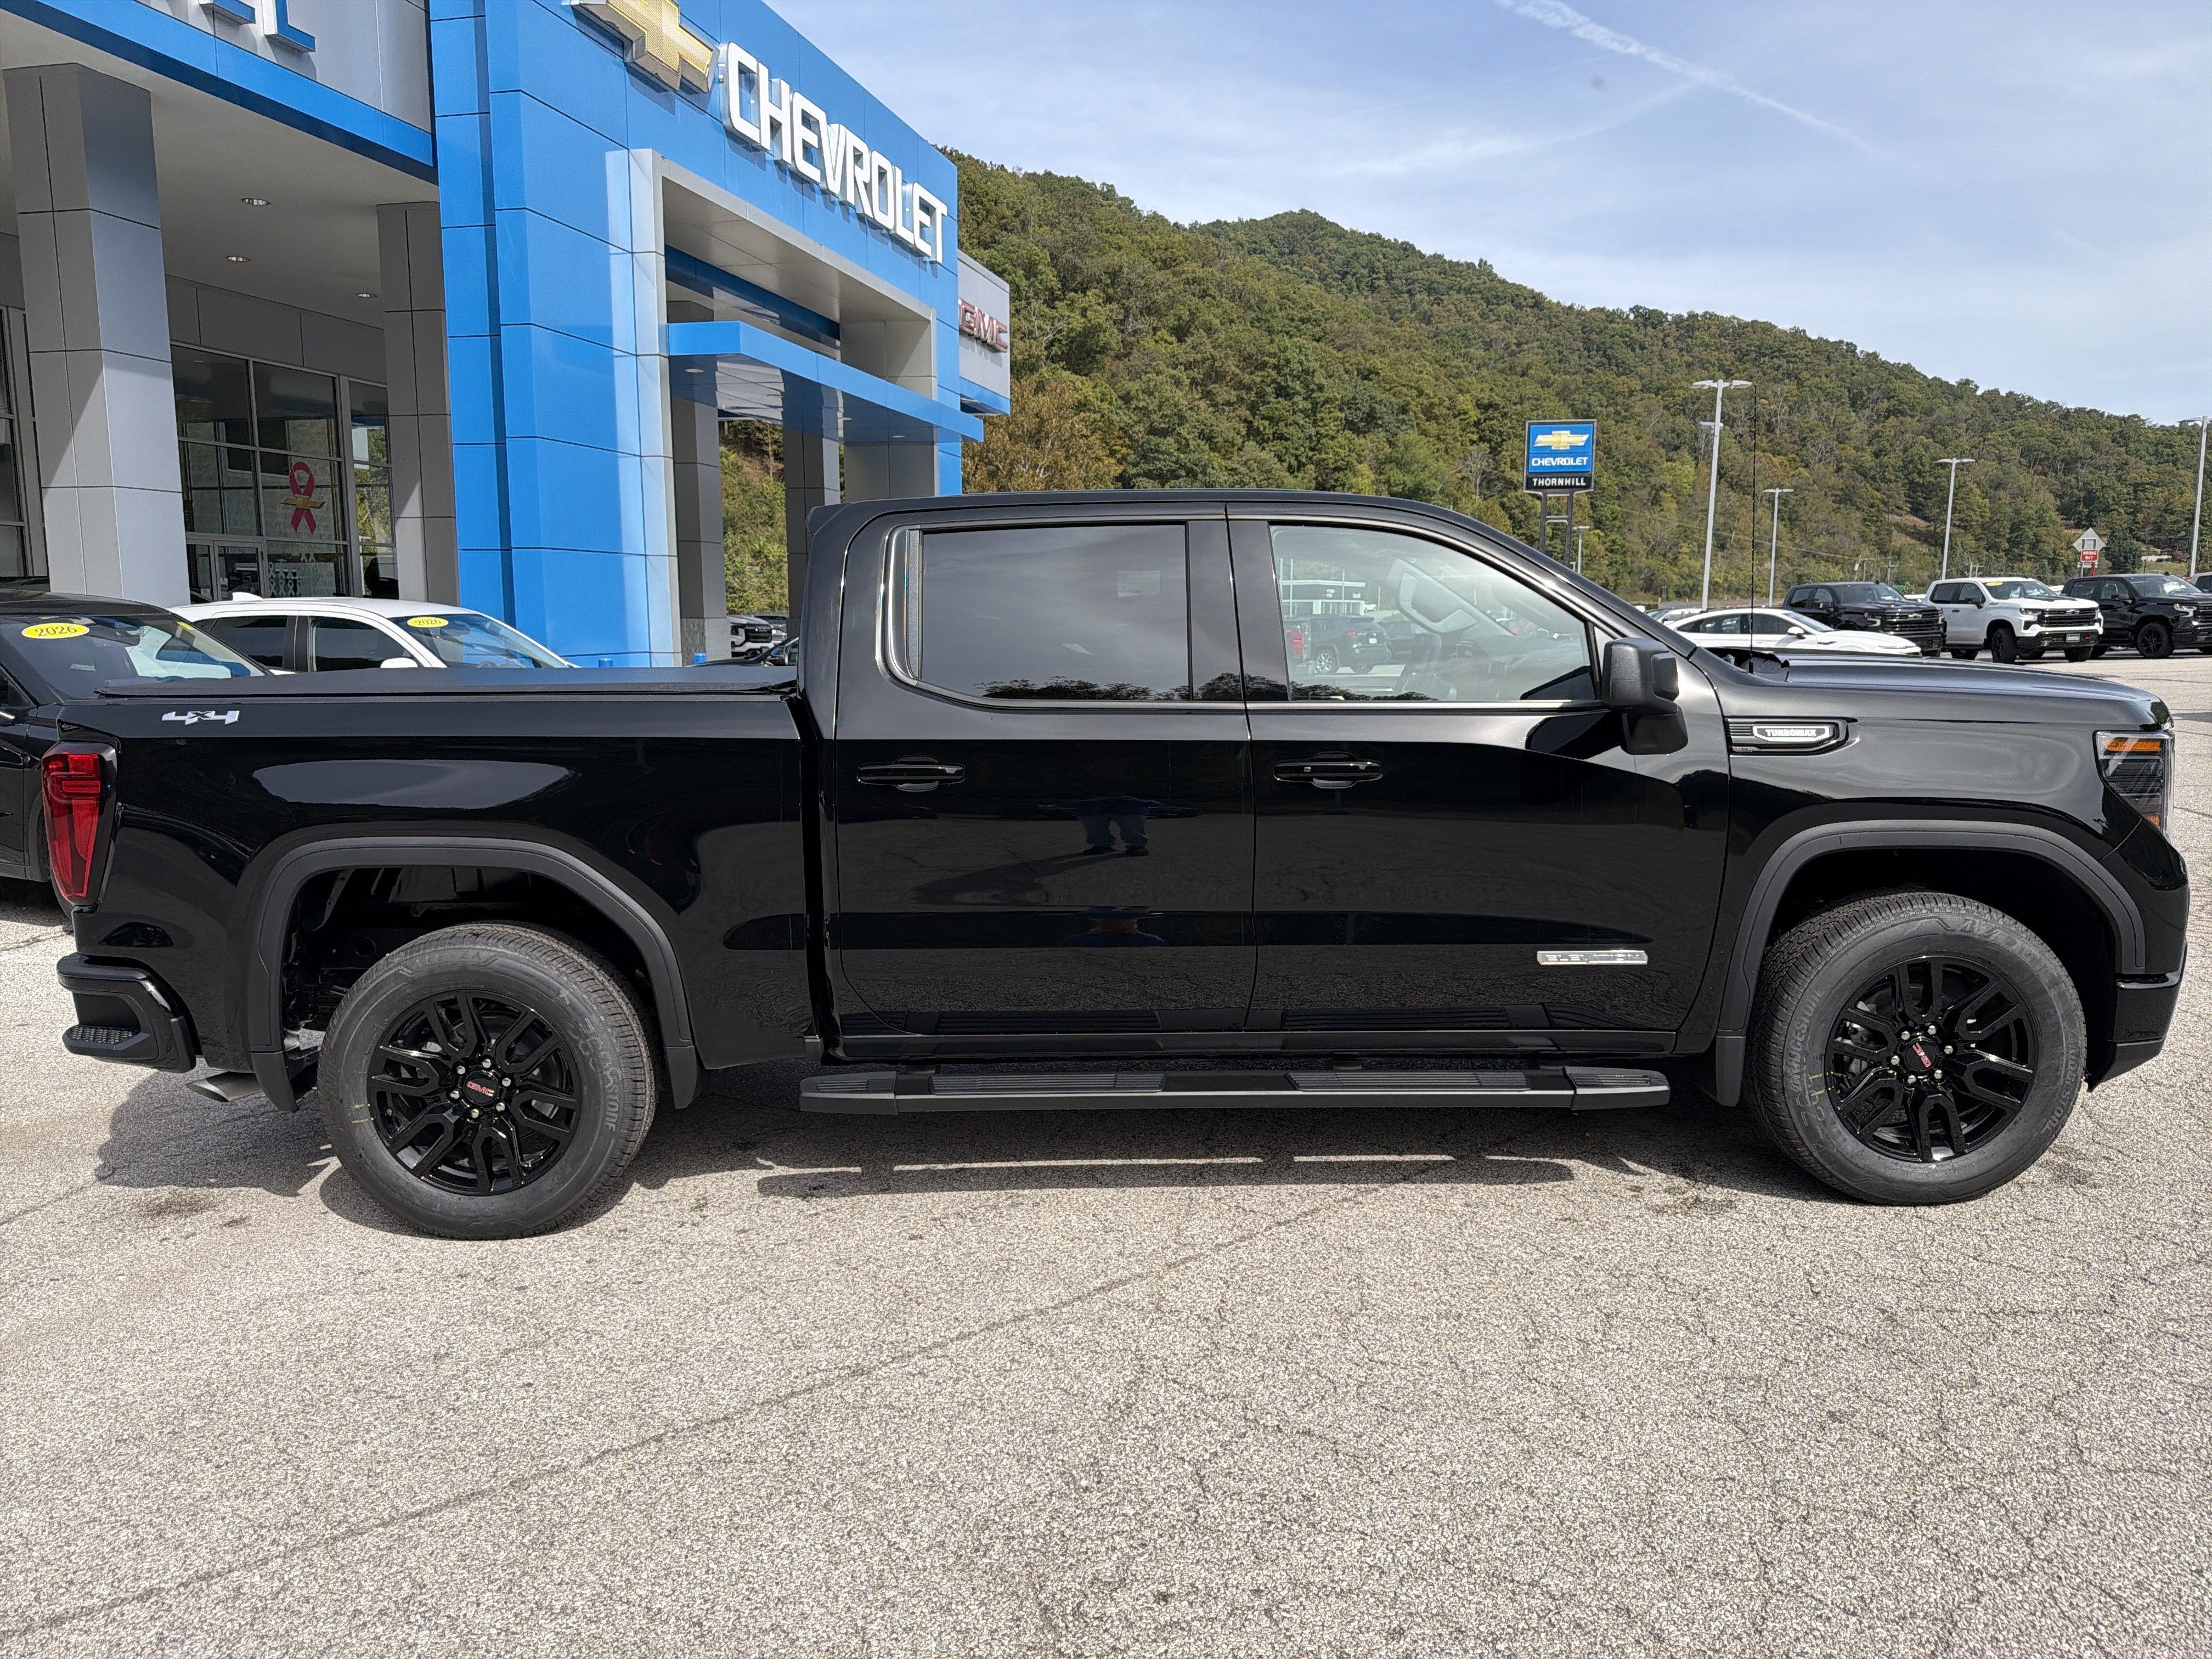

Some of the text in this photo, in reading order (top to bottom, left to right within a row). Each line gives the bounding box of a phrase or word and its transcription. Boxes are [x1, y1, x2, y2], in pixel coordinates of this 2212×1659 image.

[723, 41, 947, 264] CHEVROLET
[958, 298, 1008, 351] GMC
[1531, 456, 1589, 466] CHEVROLET
[1532, 477, 1586, 487] THORNHILL
[35, 626, 77, 636] 2026
[1765, 729, 1816, 737] TURBOMAX
[1912, 1042, 1932, 1068] GMC
[467, 1081, 495, 1097] GMC
